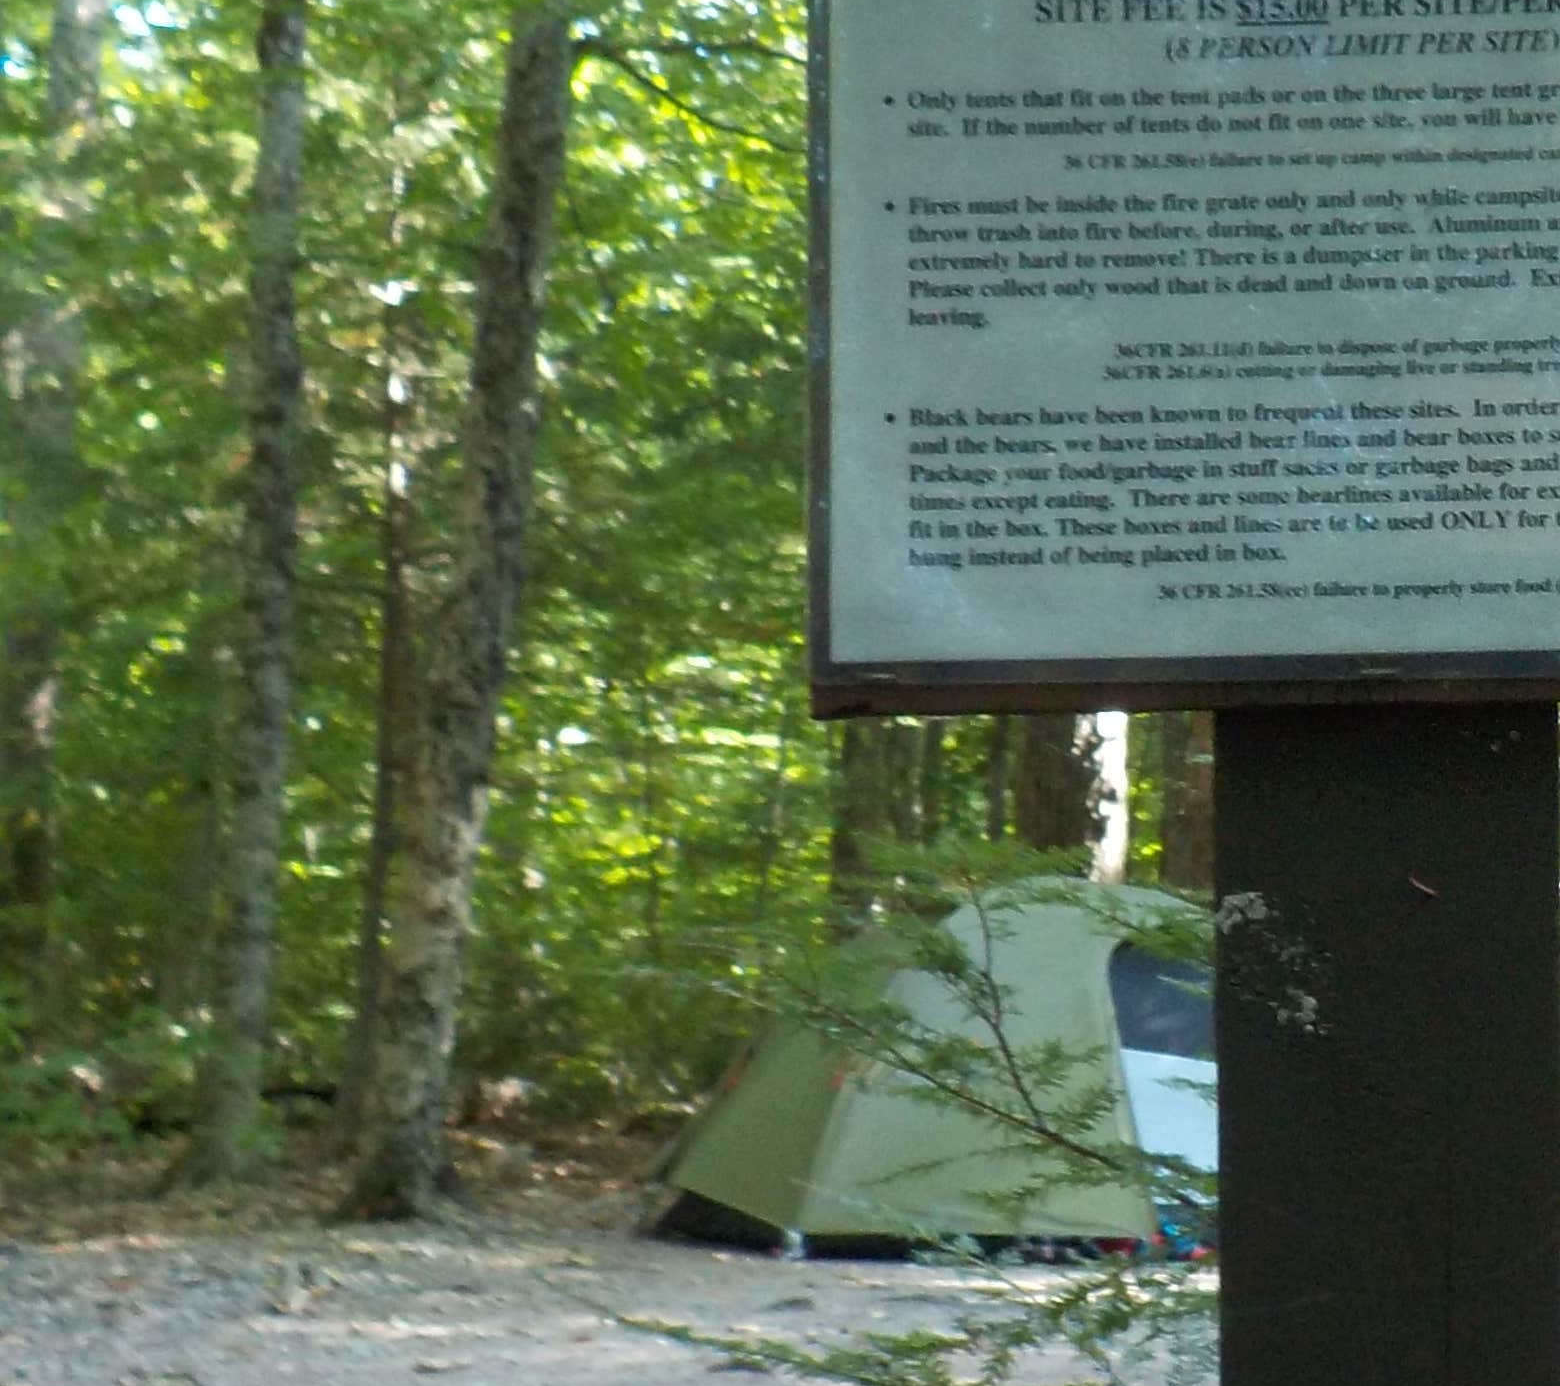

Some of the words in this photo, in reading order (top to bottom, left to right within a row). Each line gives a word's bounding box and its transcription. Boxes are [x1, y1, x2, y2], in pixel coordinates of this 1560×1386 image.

[1198, 36, 1314, 59] PERSON
[1326, 34, 1406, 56] LIMIT
[1419, 32, 1474, 54] PER
